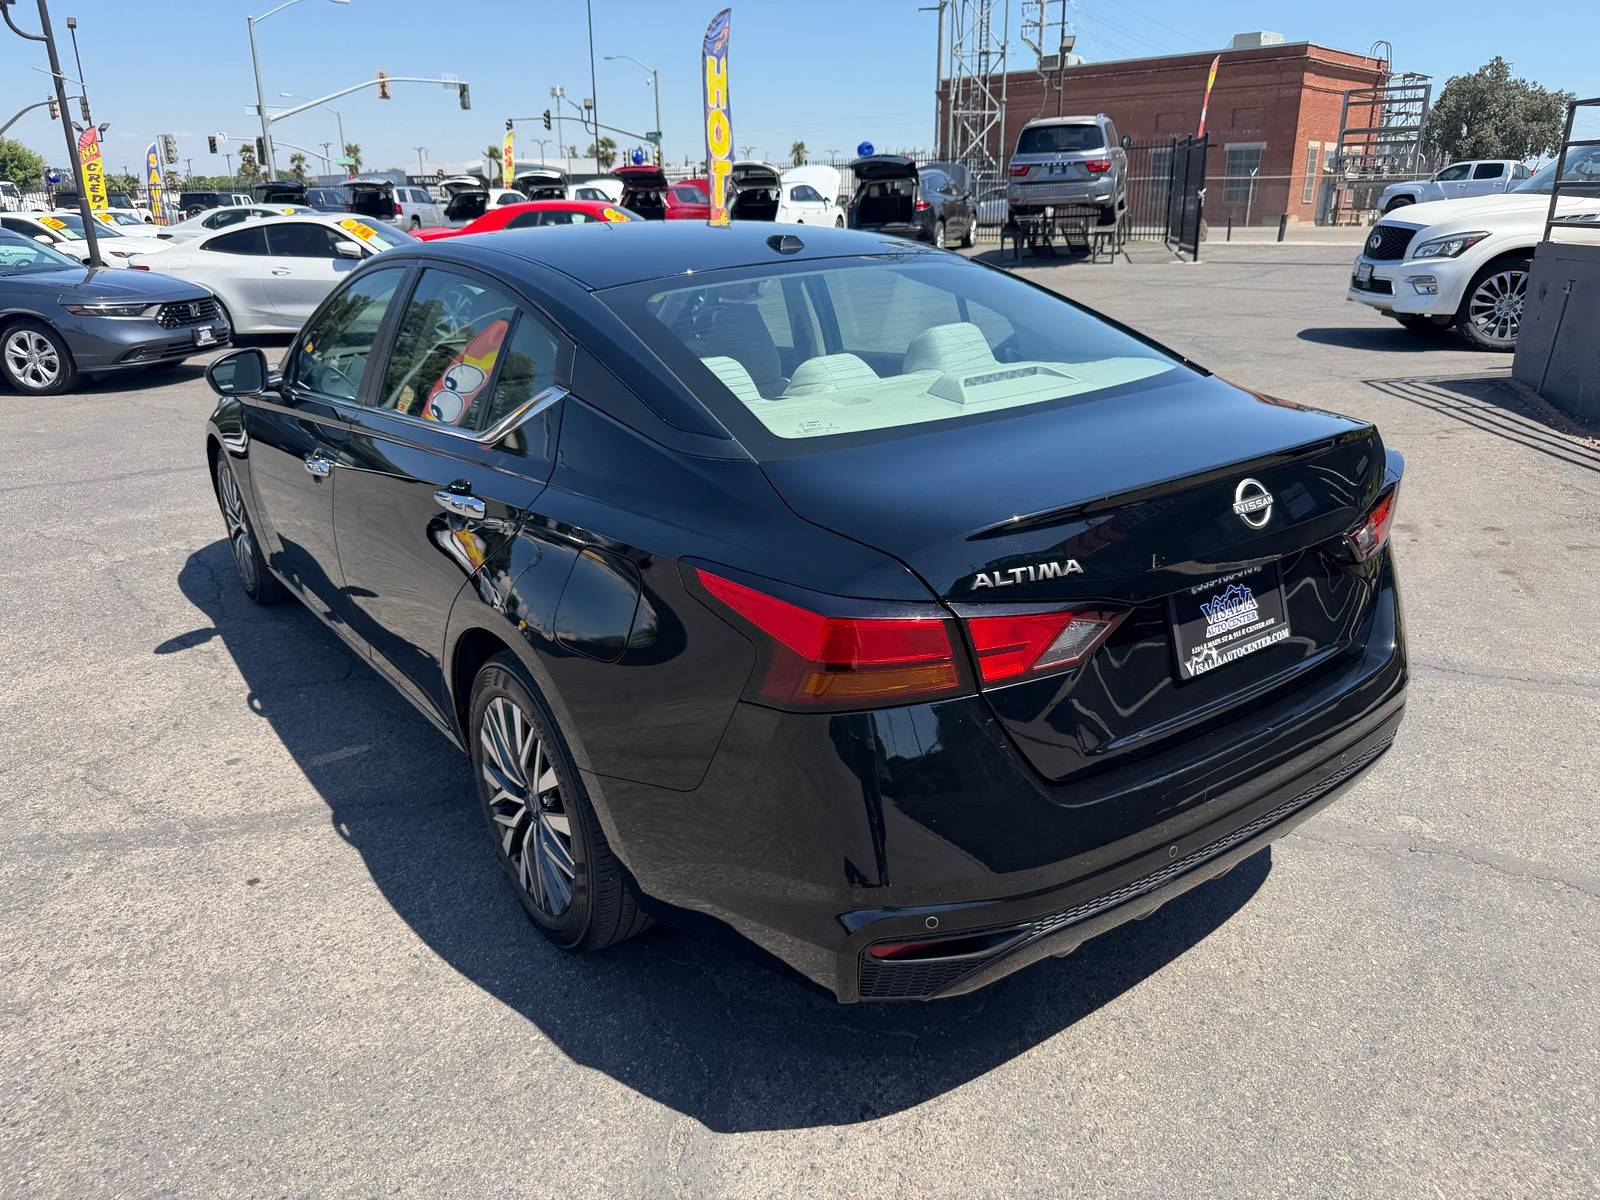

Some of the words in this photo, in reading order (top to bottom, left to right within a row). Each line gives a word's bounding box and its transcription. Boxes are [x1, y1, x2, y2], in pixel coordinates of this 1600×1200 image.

[706, 55, 732, 209] HOT
[81, 143, 98, 161] NO
[1235, 494, 1273, 514] NISSAN
[970, 559, 1084, 590] ALTIMA
[1206, 621, 1227, 638] AUTO
[1227, 611, 1258, 630] CENTER
